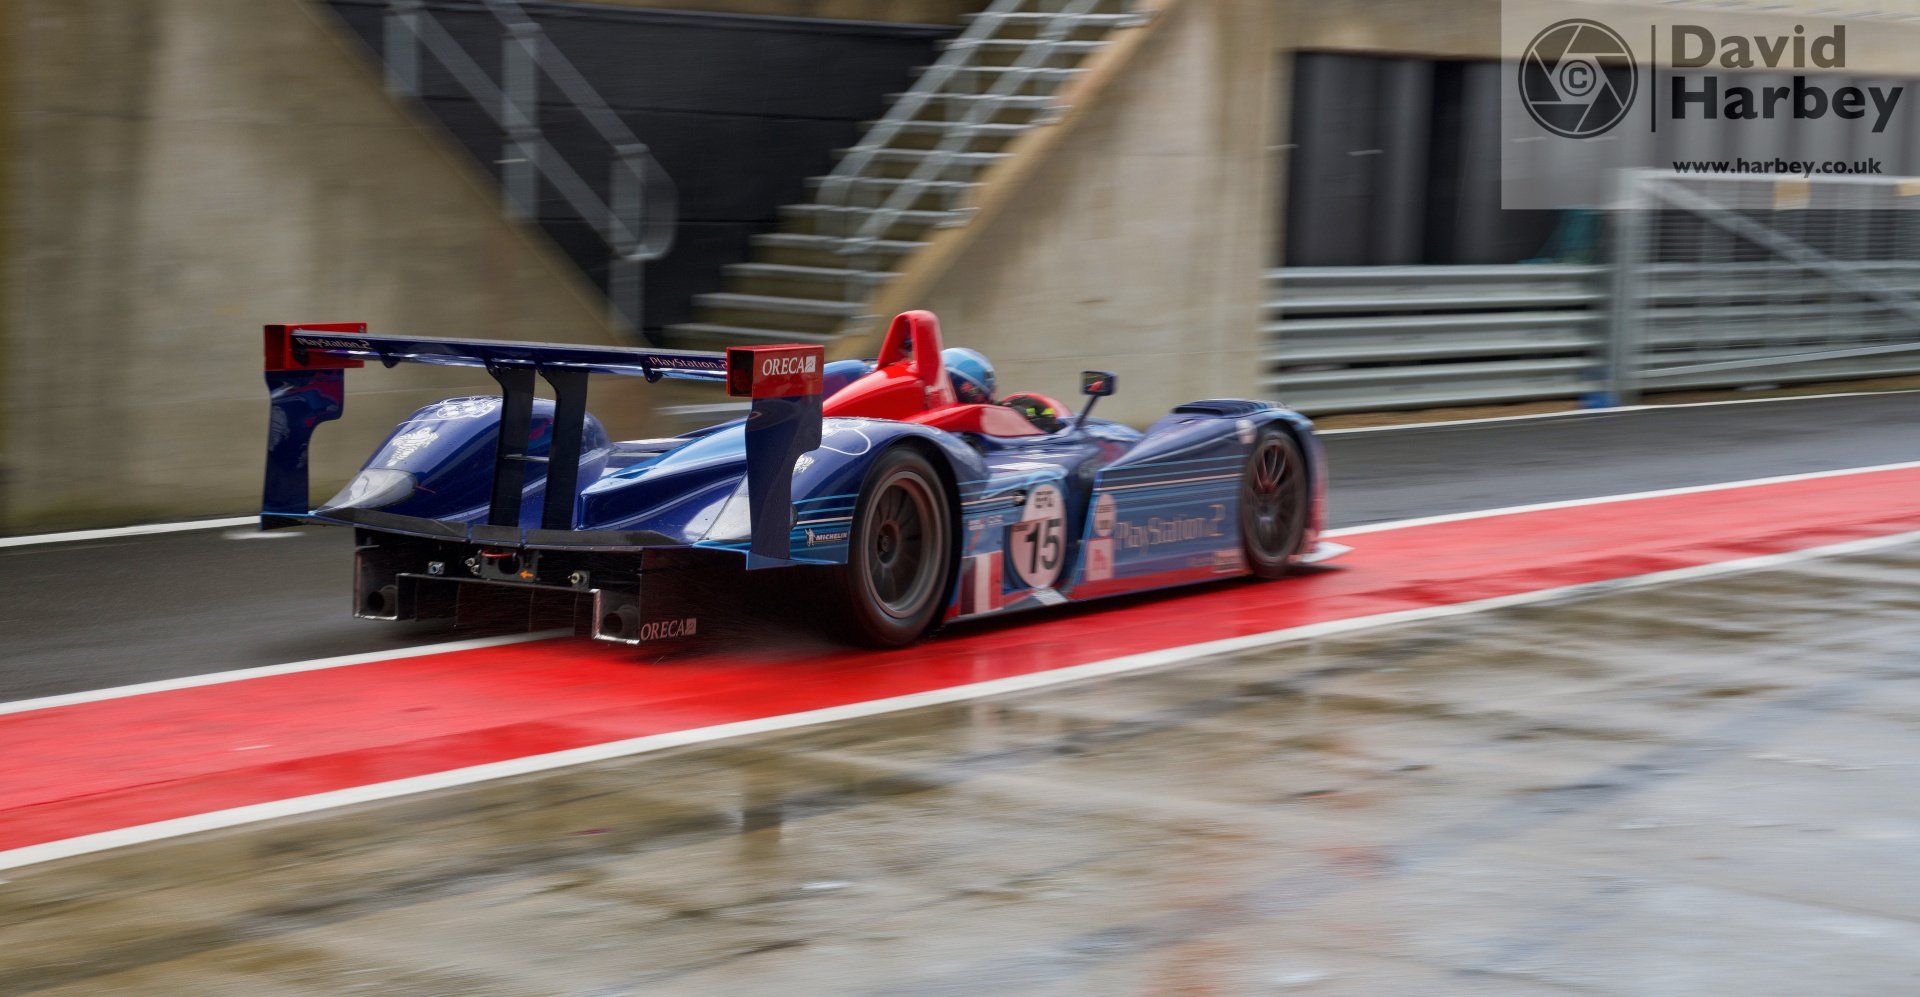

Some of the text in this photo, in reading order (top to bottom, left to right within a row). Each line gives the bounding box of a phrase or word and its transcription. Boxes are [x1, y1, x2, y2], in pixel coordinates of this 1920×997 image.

[762, 357, 806, 376] ORECA
[816, 532, 848, 541] MICHELIN
[1024, 518, 1061, 575] 15
[640, 619, 686, 641] ORECA
